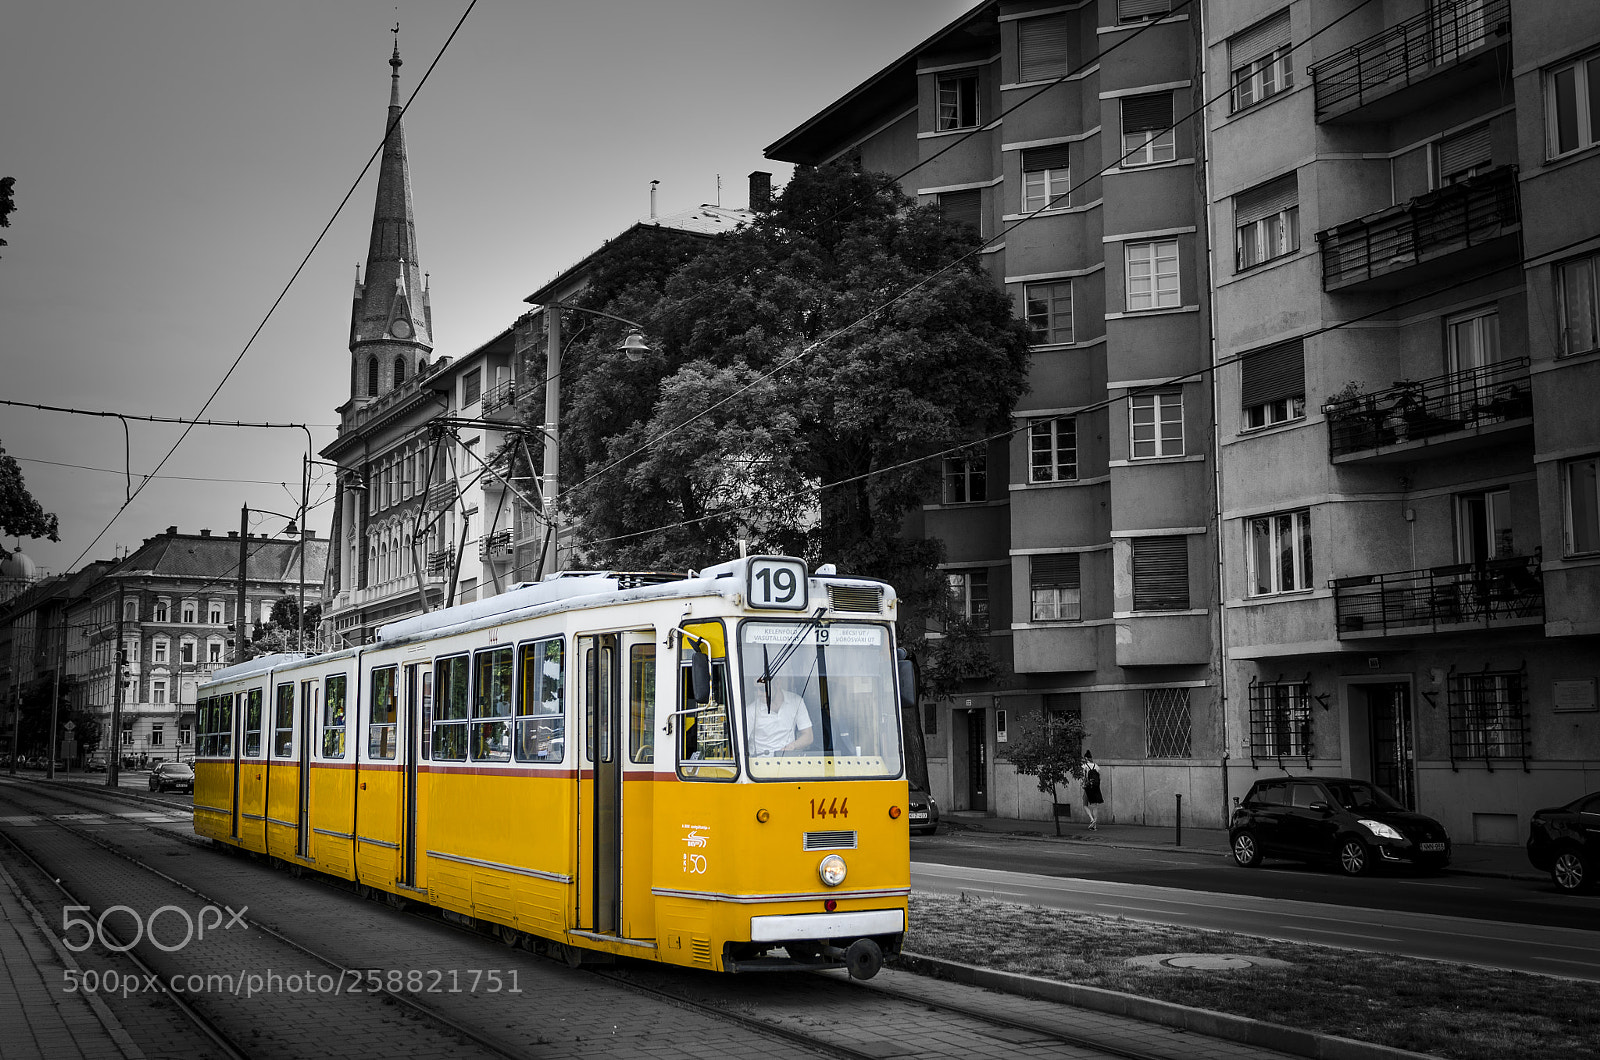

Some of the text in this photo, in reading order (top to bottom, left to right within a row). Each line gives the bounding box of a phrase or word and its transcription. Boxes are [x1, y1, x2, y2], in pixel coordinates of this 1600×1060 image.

[755, 567, 797, 603] 19
[814, 629, 829, 643] 19
[809, 797, 849, 820] 1444
[690, 854, 707, 875] 50
